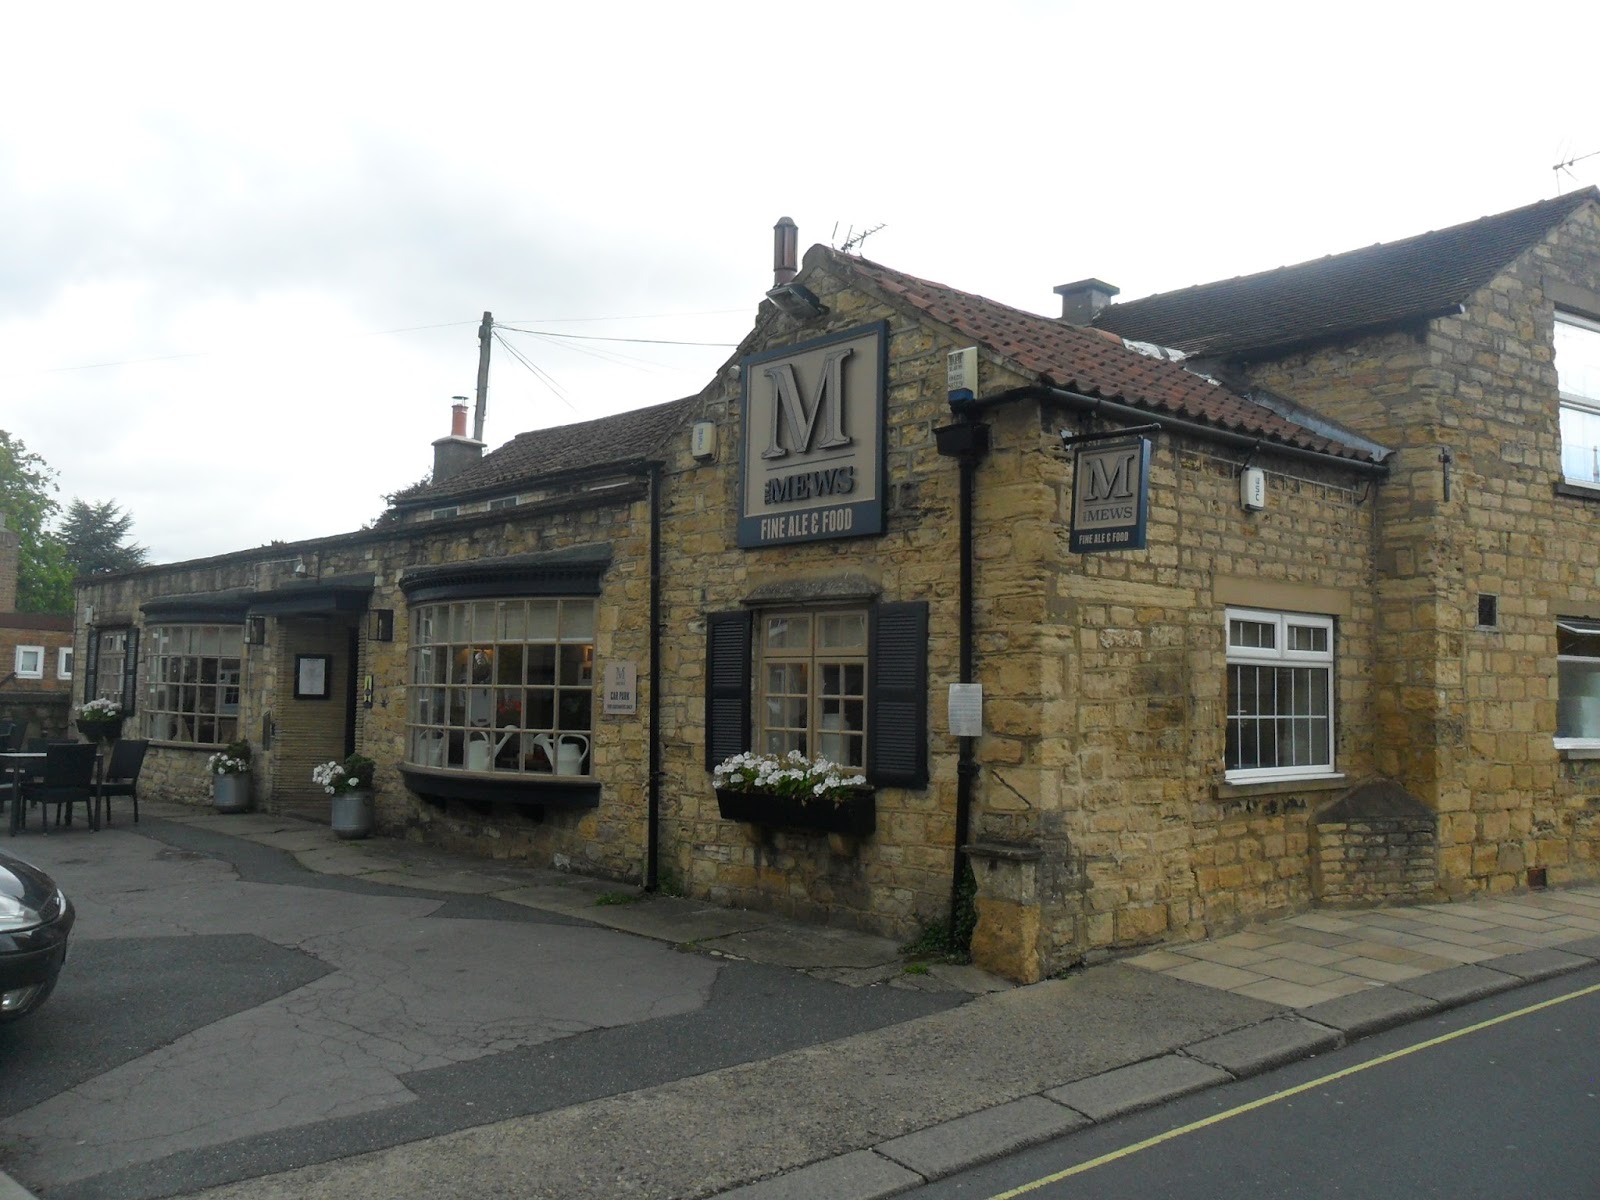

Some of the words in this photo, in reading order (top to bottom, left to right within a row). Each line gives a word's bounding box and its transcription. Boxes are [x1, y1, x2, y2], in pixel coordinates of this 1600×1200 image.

[761, 348, 854, 459] M
[769, 465, 854, 502] MEWS
[1083, 454, 1135, 501] M
[761, 517, 785, 539] FINE
[787, 514, 807, 536] ALE
[811, 513, 819, 532] &
[822, 508, 853, 532] FOOD
[1087, 506, 1133, 522] MEWS
[1079, 534, 1093, 544] FINE
[1094, 533, 1105, 543] ALE
[1112, 531, 1129, 542] FOOD
[610, 691, 618, 701] CAR
[619, 691, 630, 701] PARK
